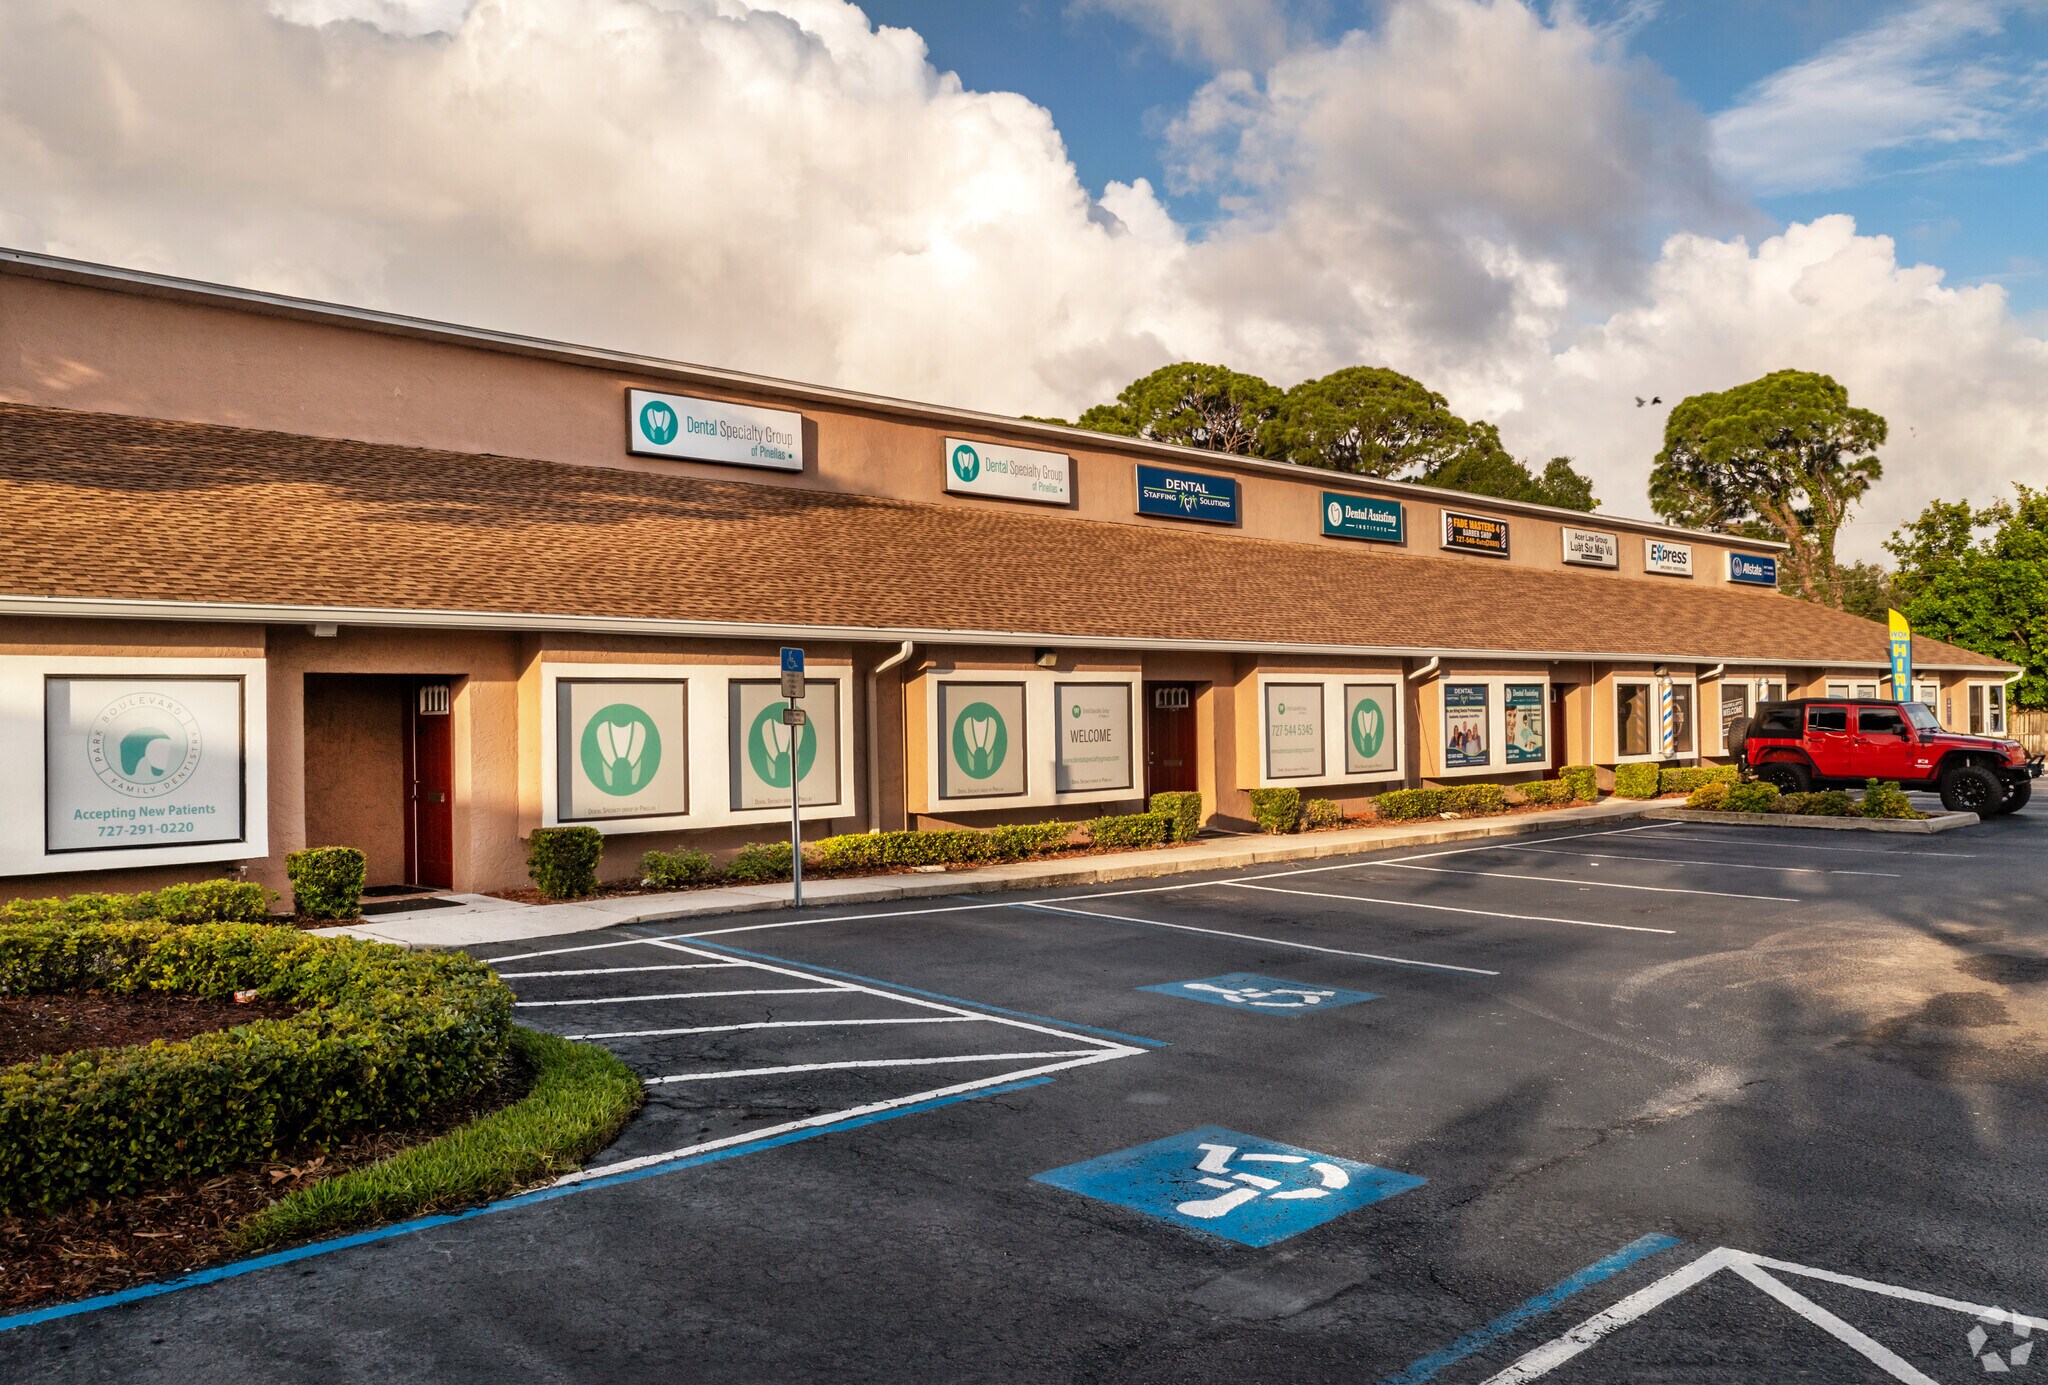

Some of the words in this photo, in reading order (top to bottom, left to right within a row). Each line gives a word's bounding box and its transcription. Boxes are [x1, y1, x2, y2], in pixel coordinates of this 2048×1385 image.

[687, 416, 717, 436] Dental
[720, 420, 763, 444] Specialty
[766, 427, 792, 448] Group
[751, 446, 758, 457] of
[760, 446, 785, 460] Pinellas
[986, 458, 1008, 474] Dental
[1010, 461, 1041, 481] Specialty
[1042, 465, 1063, 483] Group
[1032, 482, 1038, 491] of
[1039, 482, 1058, 493] Pinellas
[1166, 478, 1209, 494] DENTAL
[1144, 490, 1177, 501] STAFFING
[1200, 497, 1230, 508] SOLUTIONS
[1346, 506, 1367, 520] Dental
[1368, 509, 1397, 527] Assisting
[1356, 524, 1387, 532] INSTITUTE
[1453, 518, 1468, 529] FADE
[1469, 520, 1496, 533] MASTERS
[1462, 528, 1480, 538] BARBER
[1480, 531, 1492, 539] SHOP
[1575, 533, 1585, 541] Acer
[1586, 534, 1594, 542] Law
[1595, 536, 1608, 544] Group
[1743, 562, 1762, 576] Allstate
[1513, 689, 1524, 697] Dental
[92, 730, 103, 762] PARK
[102, 697, 181, 723] BOULEVARD
[1070, 729, 1112, 743] WELCOME
[1272, 725, 1283, 736] 727
[1284, 725, 1296, 736] 544
[1298, 724, 1313, 736] 5345
[111, 778, 156, 794] FAMILY
[164, 732, 199, 789] DENTISTRY
[74, 808, 136, 821] Accepting
[140, 806, 165, 817] New
[168, 804, 216, 816] Patients
[98, 822, 194, 837] 727-291-0220
